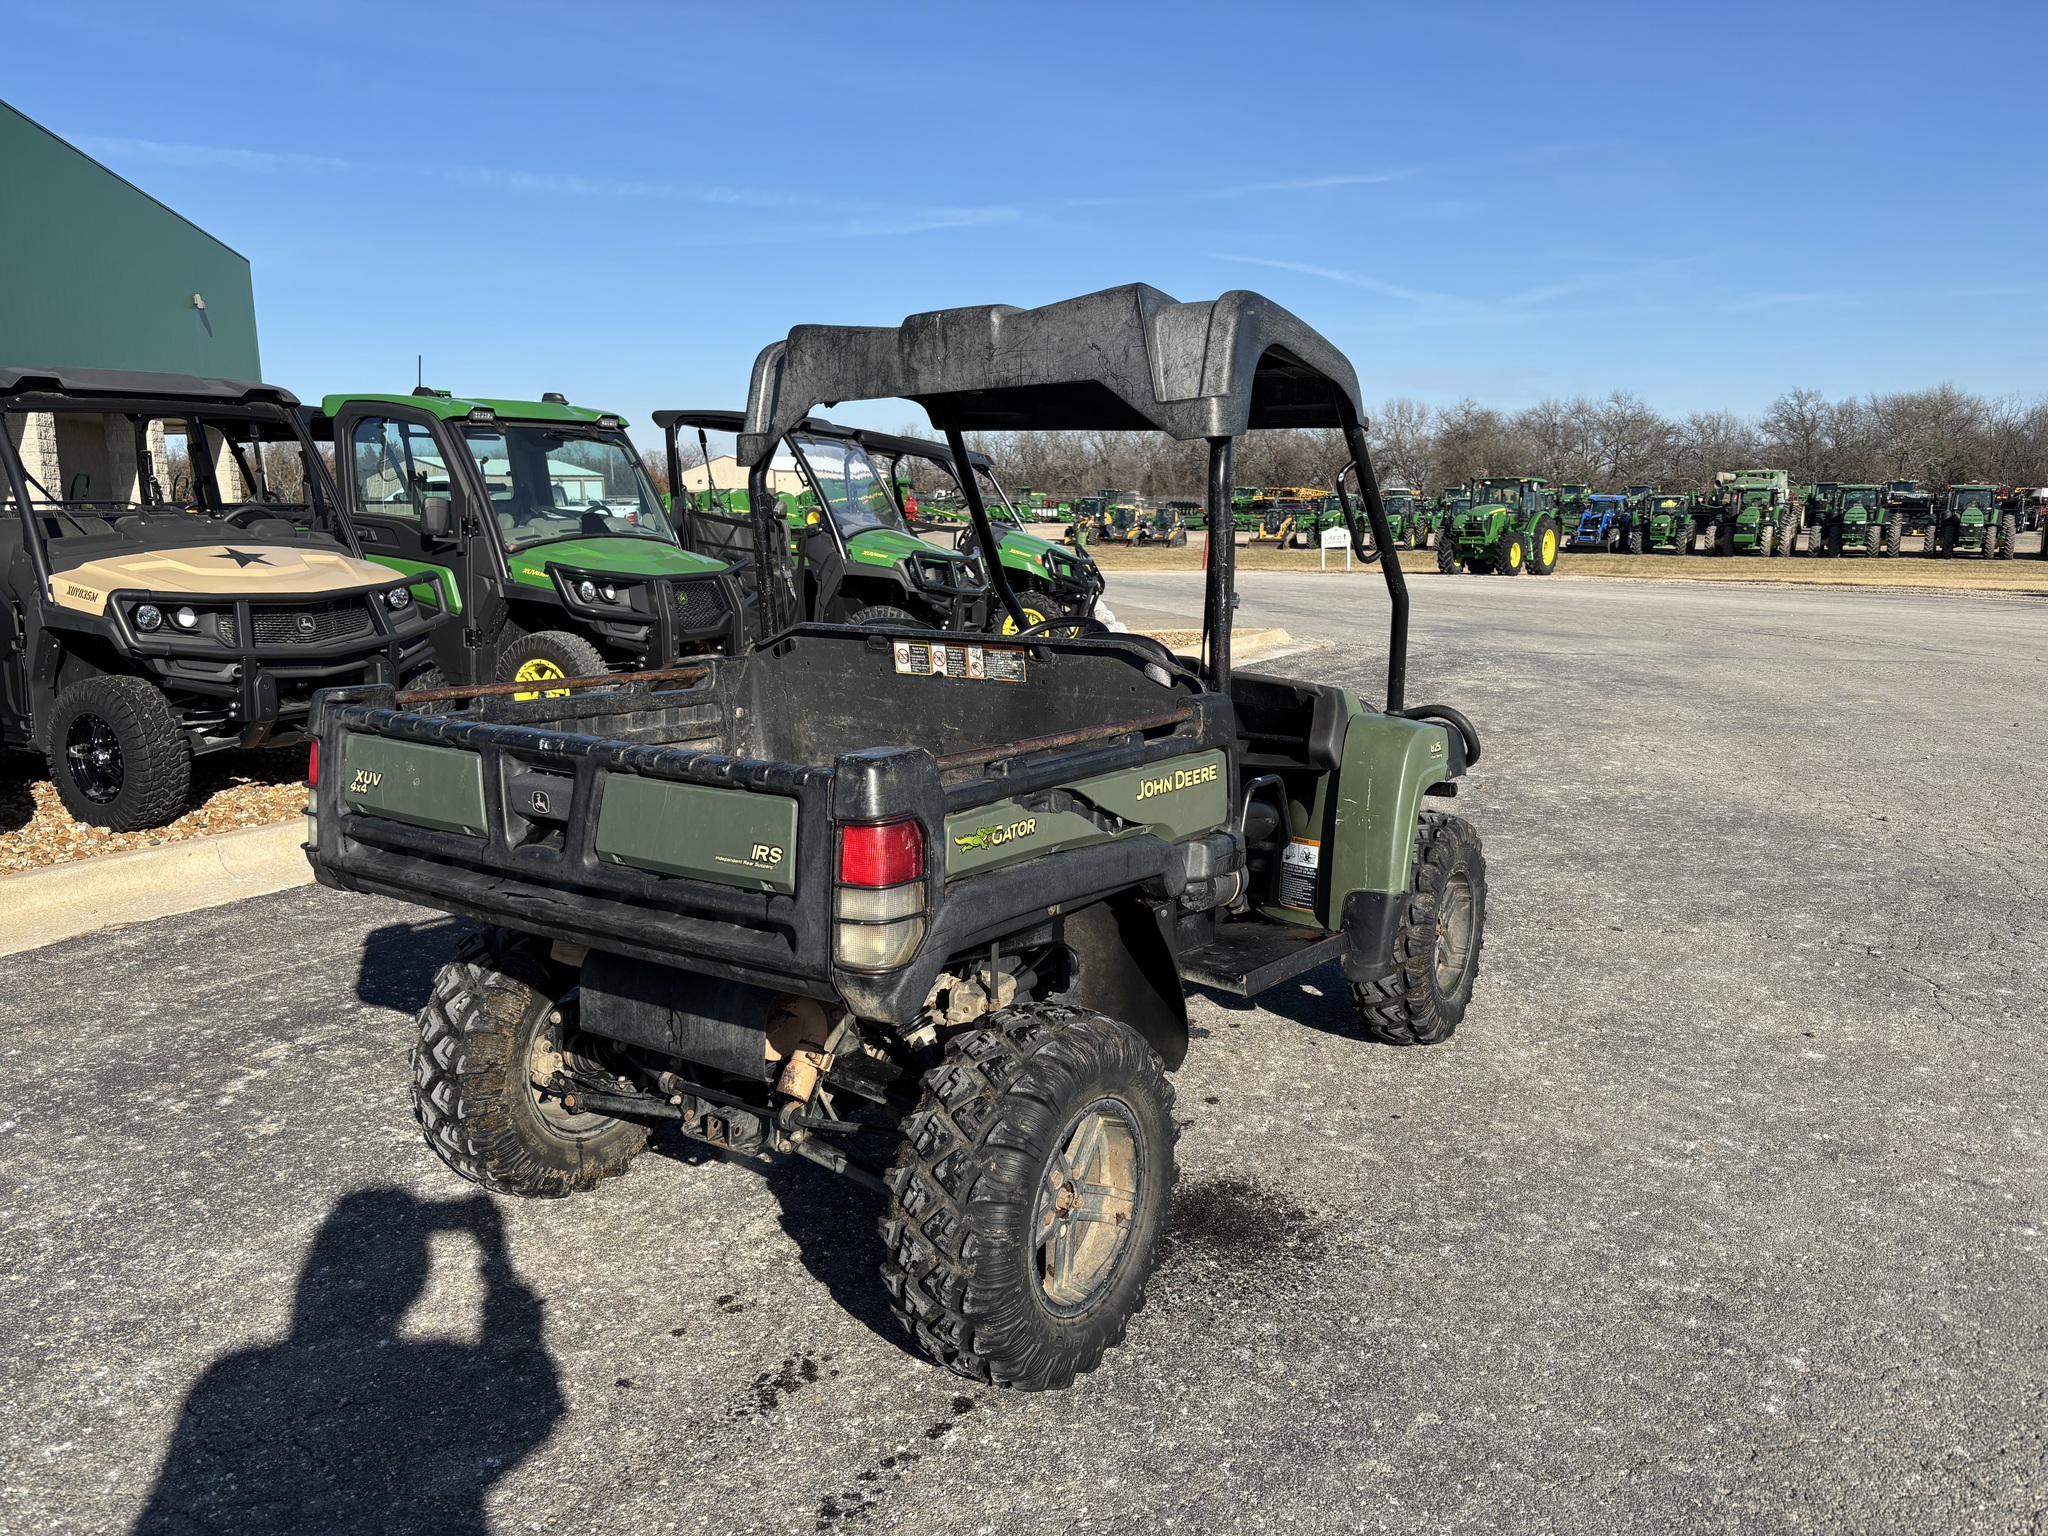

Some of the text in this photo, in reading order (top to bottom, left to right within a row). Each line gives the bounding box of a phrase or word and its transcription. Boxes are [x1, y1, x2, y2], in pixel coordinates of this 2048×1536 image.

[66, 585, 99, 602] XUV835M
[354, 769, 383, 787] XUV
[1136, 765, 1217, 801] JOHN DEERE
[992, 818, 1036, 845] GATOR
[751, 843, 784, 864] IRS
